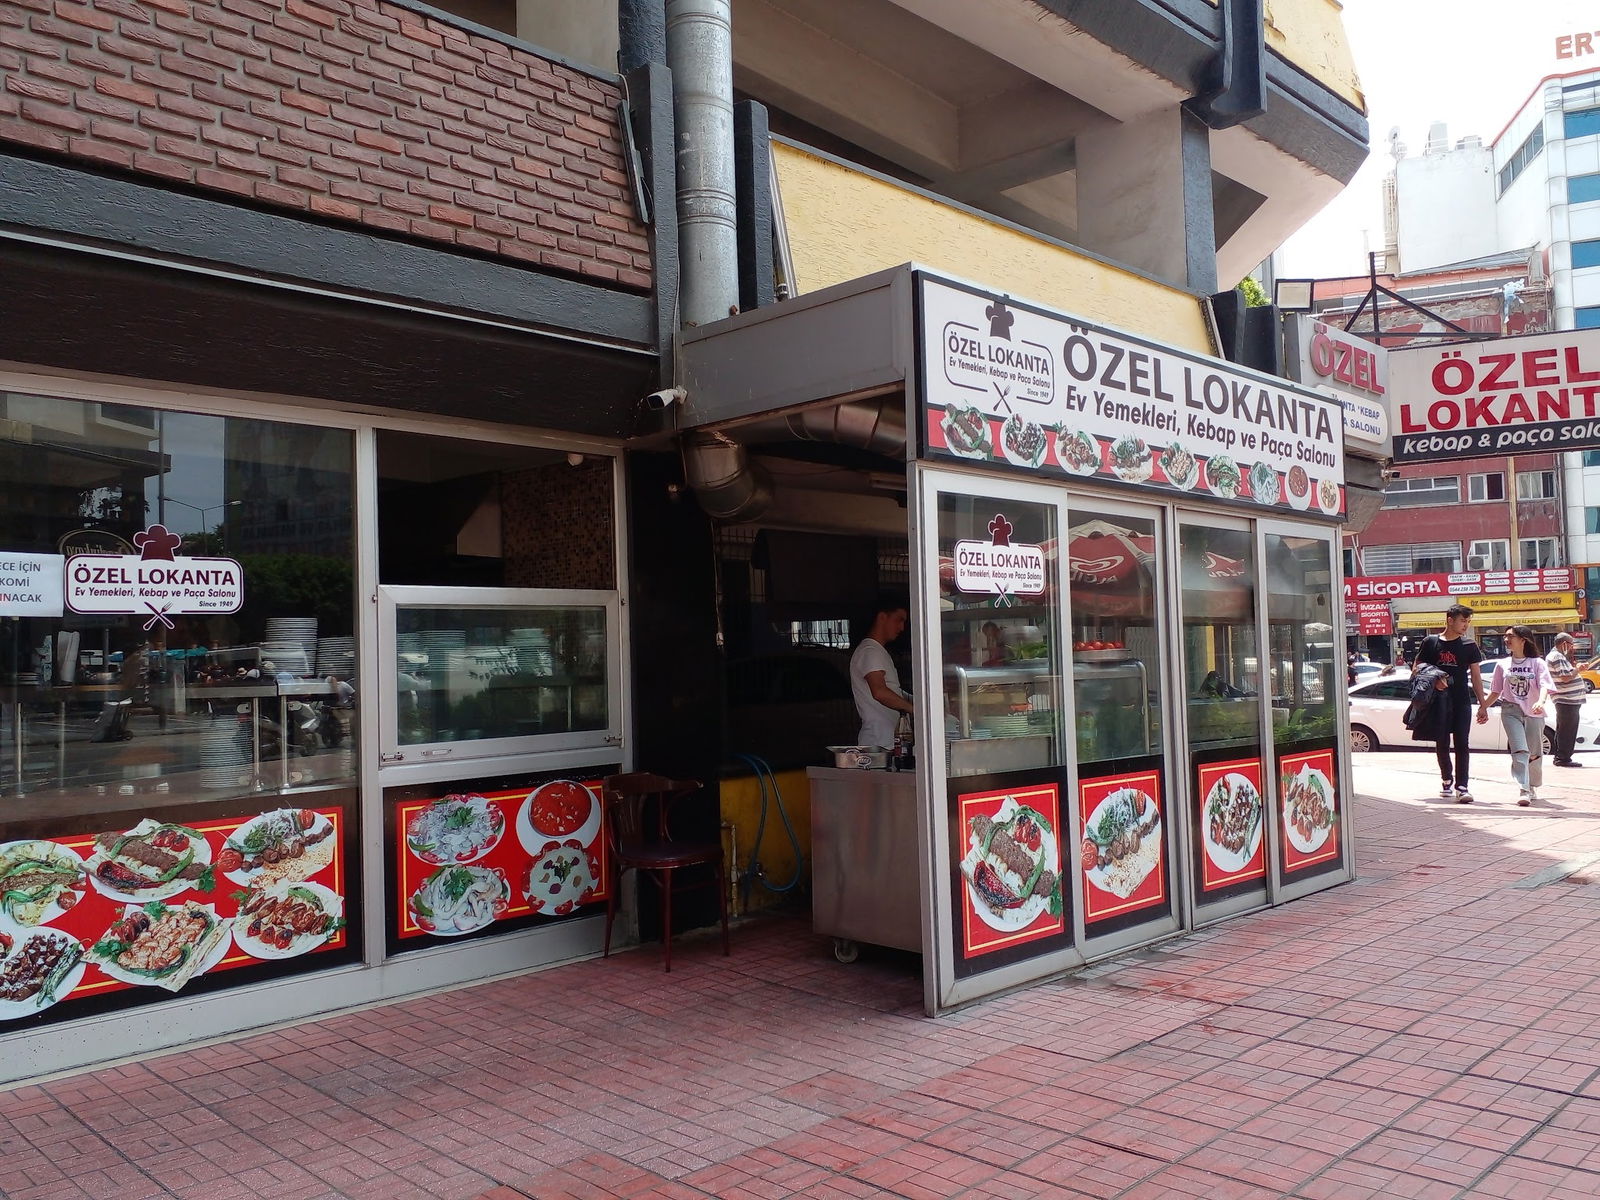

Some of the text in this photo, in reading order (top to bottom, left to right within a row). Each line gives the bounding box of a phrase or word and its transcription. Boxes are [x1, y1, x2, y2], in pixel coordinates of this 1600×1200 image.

[948, 330, 1050, 375] ÖZEL LOKANTA
[1310, 323, 1385, 394] ÖZEL
[949, 356, 956, 367] Ev
[989, 366, 1008, 381] Kebap
[1010, 372, 1016, 381] ve
[1017, 372, 1031, 386] Paça
[1032, 377, 1050, 389] Salonu
[1063, 324, 1334, 443] ÖZEL LOKANTA
[1431, 346, 1600, 396] ÖZEL
[1066, 385, 1336, 468] Ev Yemekleri, Kebap ve Paça Salonu
[1350, 419, 1381, 436] SALONU
[1403, 435, 1473, 454] kebap
[1478, 433, 1491, 447] &
[1496, 427, 1554, 449] paça
[0, 561, 41, 573] CE İÇİN
[959, 548, 1041, 569] ÖZEL LOKANTA
[74, 563, 235, 586] ÖZEL LOKANTA
[992, 570, 1007, 580] Kebap
[75, 586, 236, 600] Ev Yemekleri, Kebap ve Paça Salonu
[1357, 581, 1441, 596] SİGORTA
